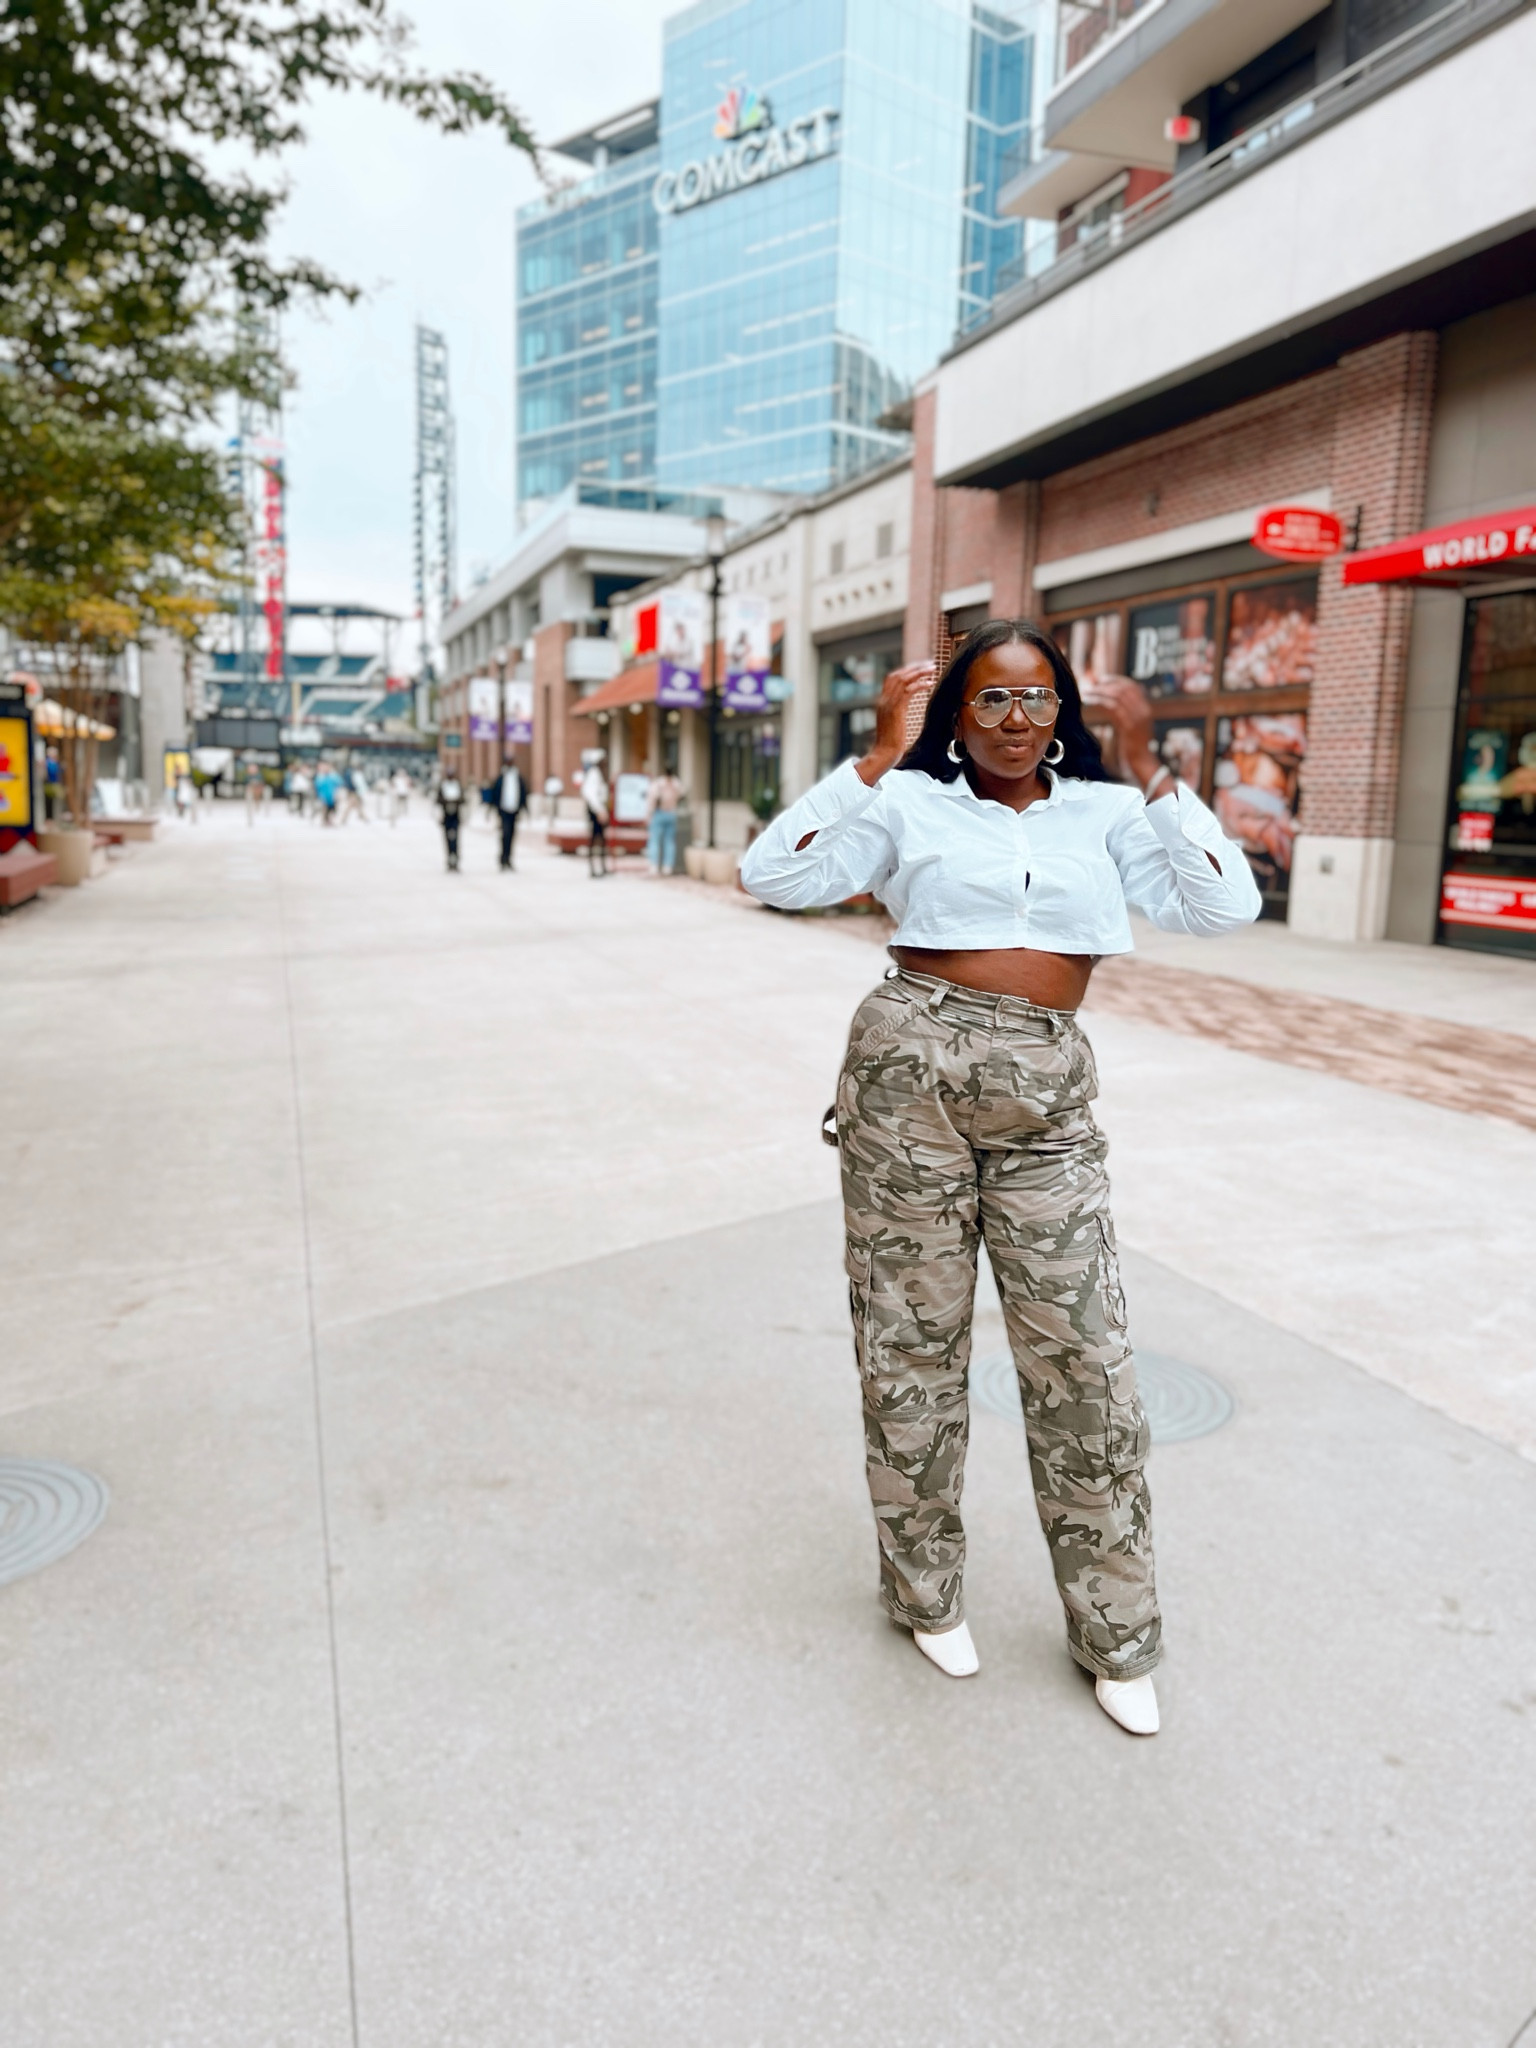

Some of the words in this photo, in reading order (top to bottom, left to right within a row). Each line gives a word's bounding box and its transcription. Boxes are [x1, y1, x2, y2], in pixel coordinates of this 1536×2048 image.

[652, 106, 840, 214] COMCAST
[1422, 530, 1509, 570] WORLD
[1133, 626, 1158, 680] B
